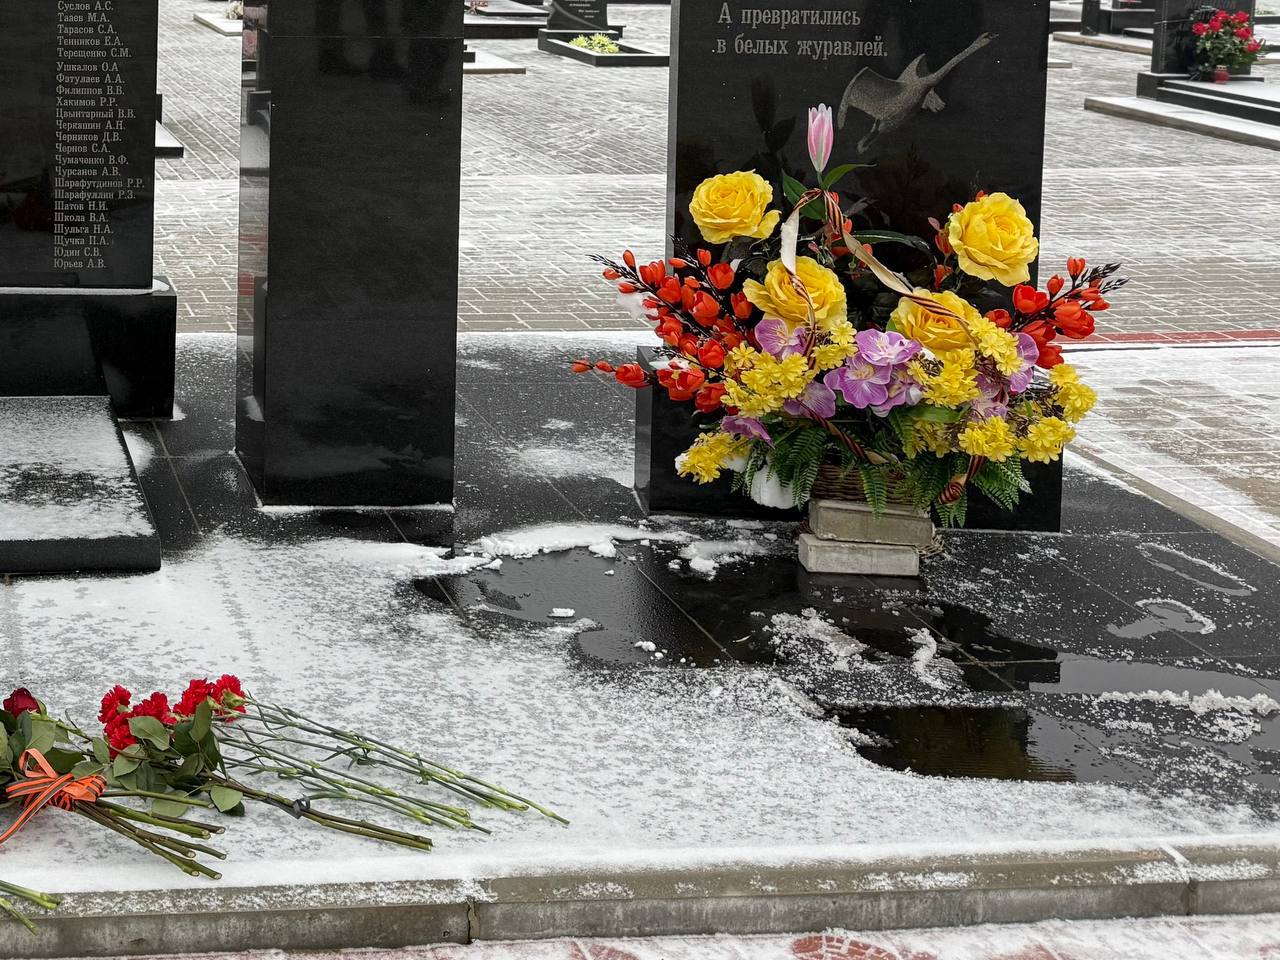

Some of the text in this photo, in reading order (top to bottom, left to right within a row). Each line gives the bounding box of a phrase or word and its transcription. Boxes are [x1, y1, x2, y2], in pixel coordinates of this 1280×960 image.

[57, 0, 91, 12] Суслов
[717, 2, 861, 29] А превратились
[57, 24, 94, 36] Тарасов
[716, 33, 888, 60] в белых журавлей.
[56, 47, 107, 60] Терещенко
[55, 154, 105, 166] Чумаченко
[53, 258, 84, 270] Юрьев
